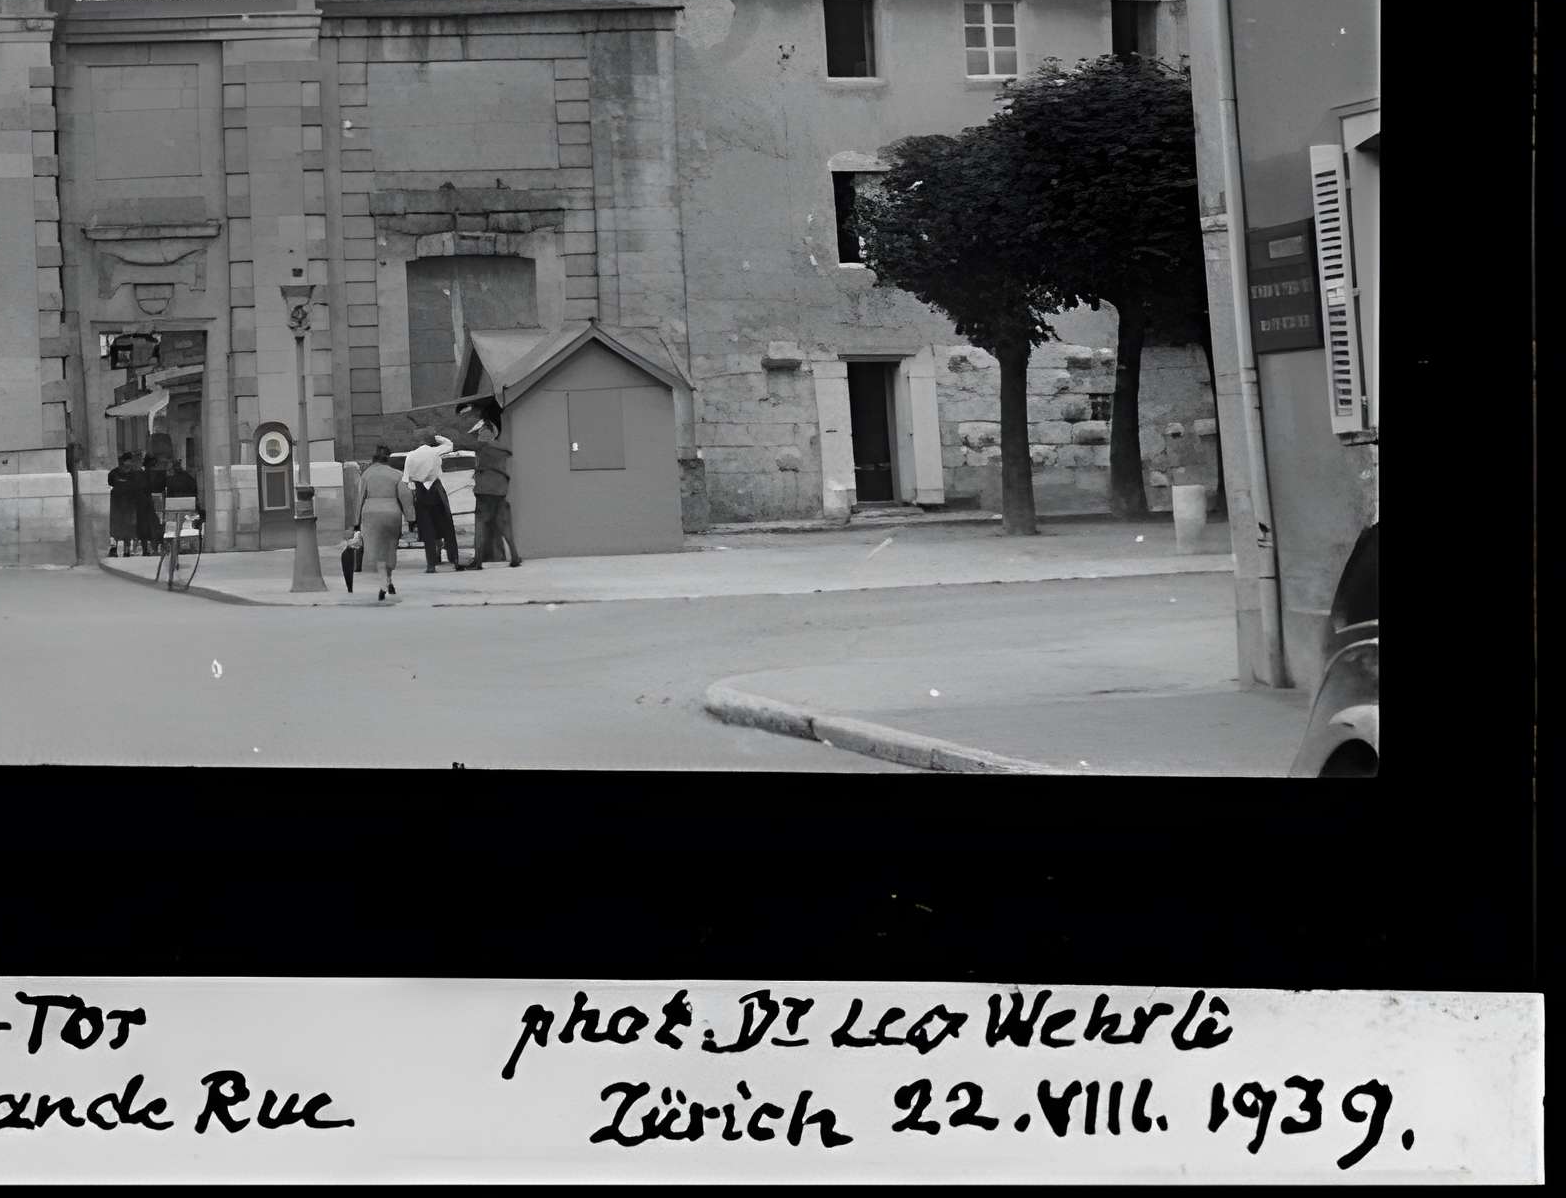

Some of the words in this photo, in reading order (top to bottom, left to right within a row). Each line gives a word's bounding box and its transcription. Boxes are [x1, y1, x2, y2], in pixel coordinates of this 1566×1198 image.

[831, 999, 969, 1054] Leo
[986, 990, 1234, 1050] Wehrli
[590, 1081, 854, 1148] Zürich
